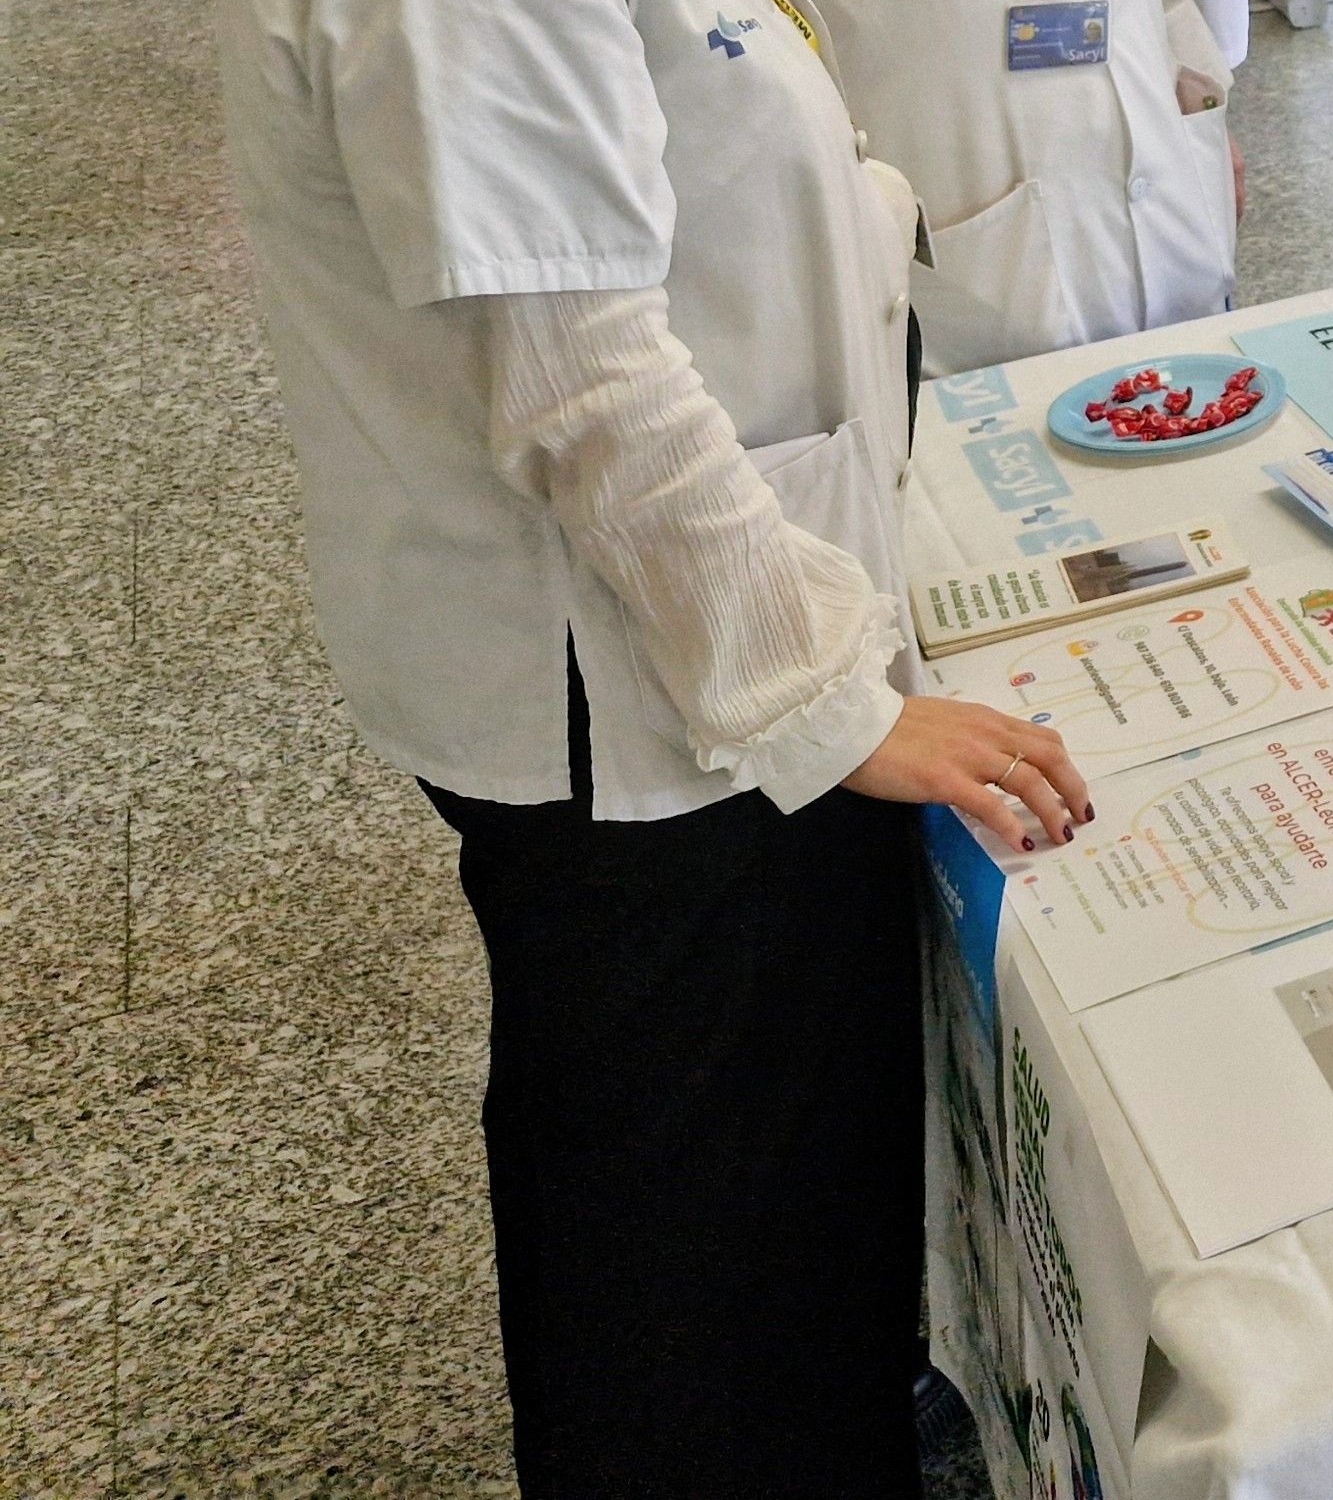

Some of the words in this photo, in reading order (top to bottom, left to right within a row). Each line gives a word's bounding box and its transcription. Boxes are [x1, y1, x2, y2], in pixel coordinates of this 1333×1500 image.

[1068, 48, 1104, 62] Sacyl
[989, 443, 1055, 497] Sacyl
[1268, 743, 1287, 759] en
[1250, 783, 1284, 812] para
[1276, 813, 1327, 869] ayudarte
